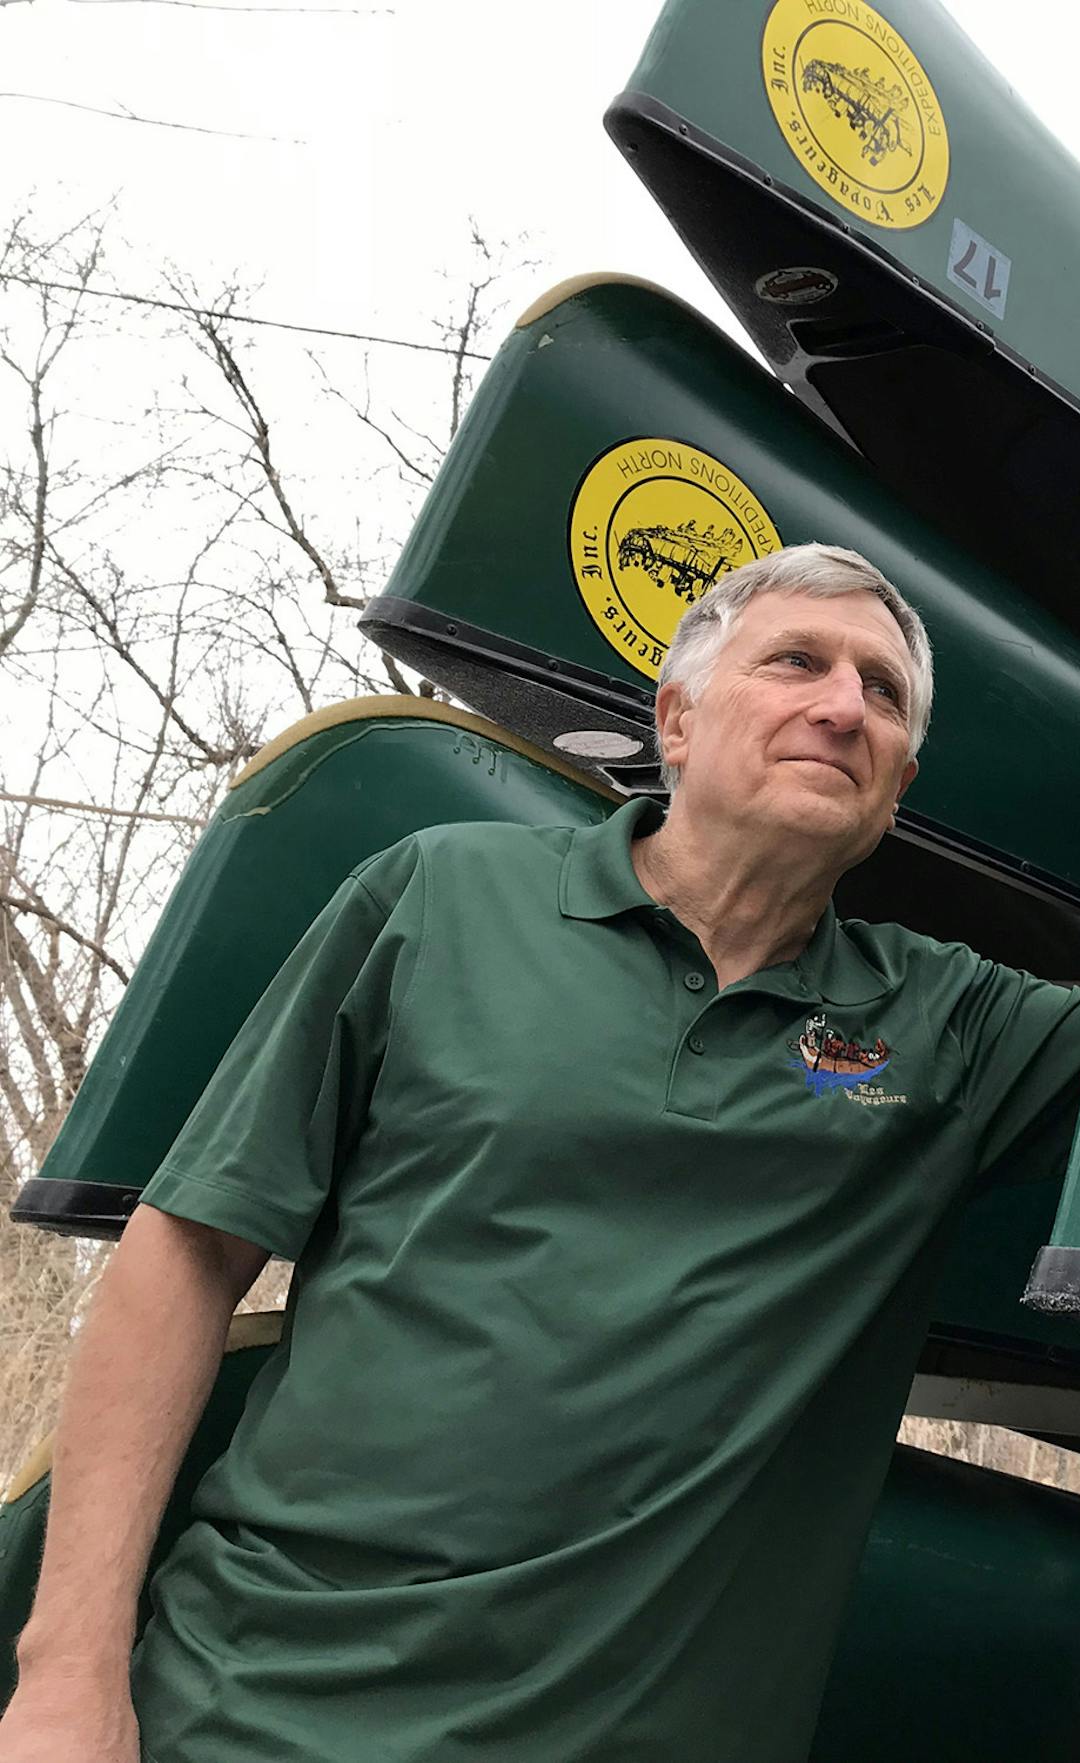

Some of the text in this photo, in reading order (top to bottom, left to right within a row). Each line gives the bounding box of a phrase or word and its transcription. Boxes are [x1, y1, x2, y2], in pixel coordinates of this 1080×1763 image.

[771, 45, 789, 95] Inc.
[865, 14, 941, 137] EXPEDITIONS
[904, 182, 936, 216] Les
[953, 239, 1001, 300] 17
[616, 449, 774, 555] XPEDITIONS NORTH
[581, 525, 666, 667] geurs. Inc.
